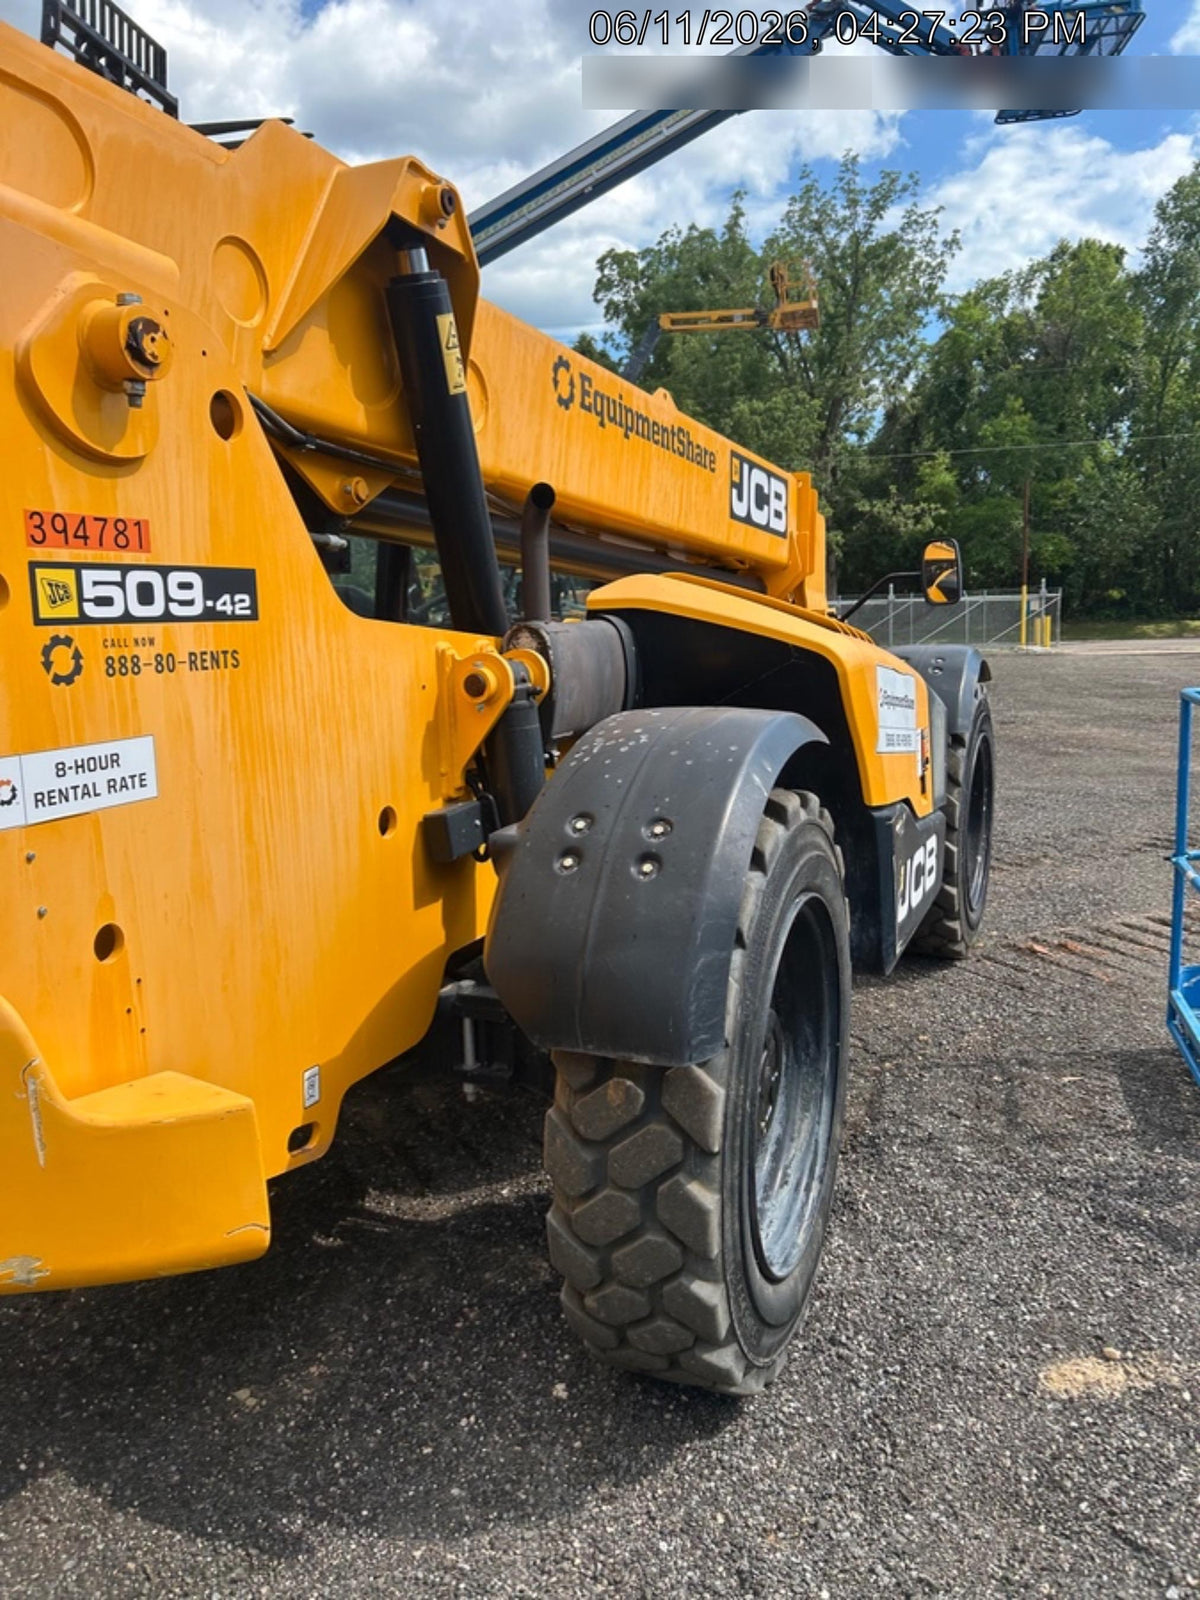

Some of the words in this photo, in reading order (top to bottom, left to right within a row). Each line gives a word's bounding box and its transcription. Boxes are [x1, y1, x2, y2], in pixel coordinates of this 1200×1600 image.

[579, 372, 716, 473] EquipmentShare
[732, 461, 787, 532] JCB
[28, 511, 144, 550] 394781
[80, 568, 252, 618] 509-42
[102, 638, 129, 649] CALL
[133, 636, 156, 648] NOW
[104, 650, 241, 678] 888-80-RENTS
[54, 752, 121, 779] 8-HOUR
[33, 781, 102, 809] RENTAL
[106, 772, 149, 796] RATE
[896, 833, 938, 923] JCB
